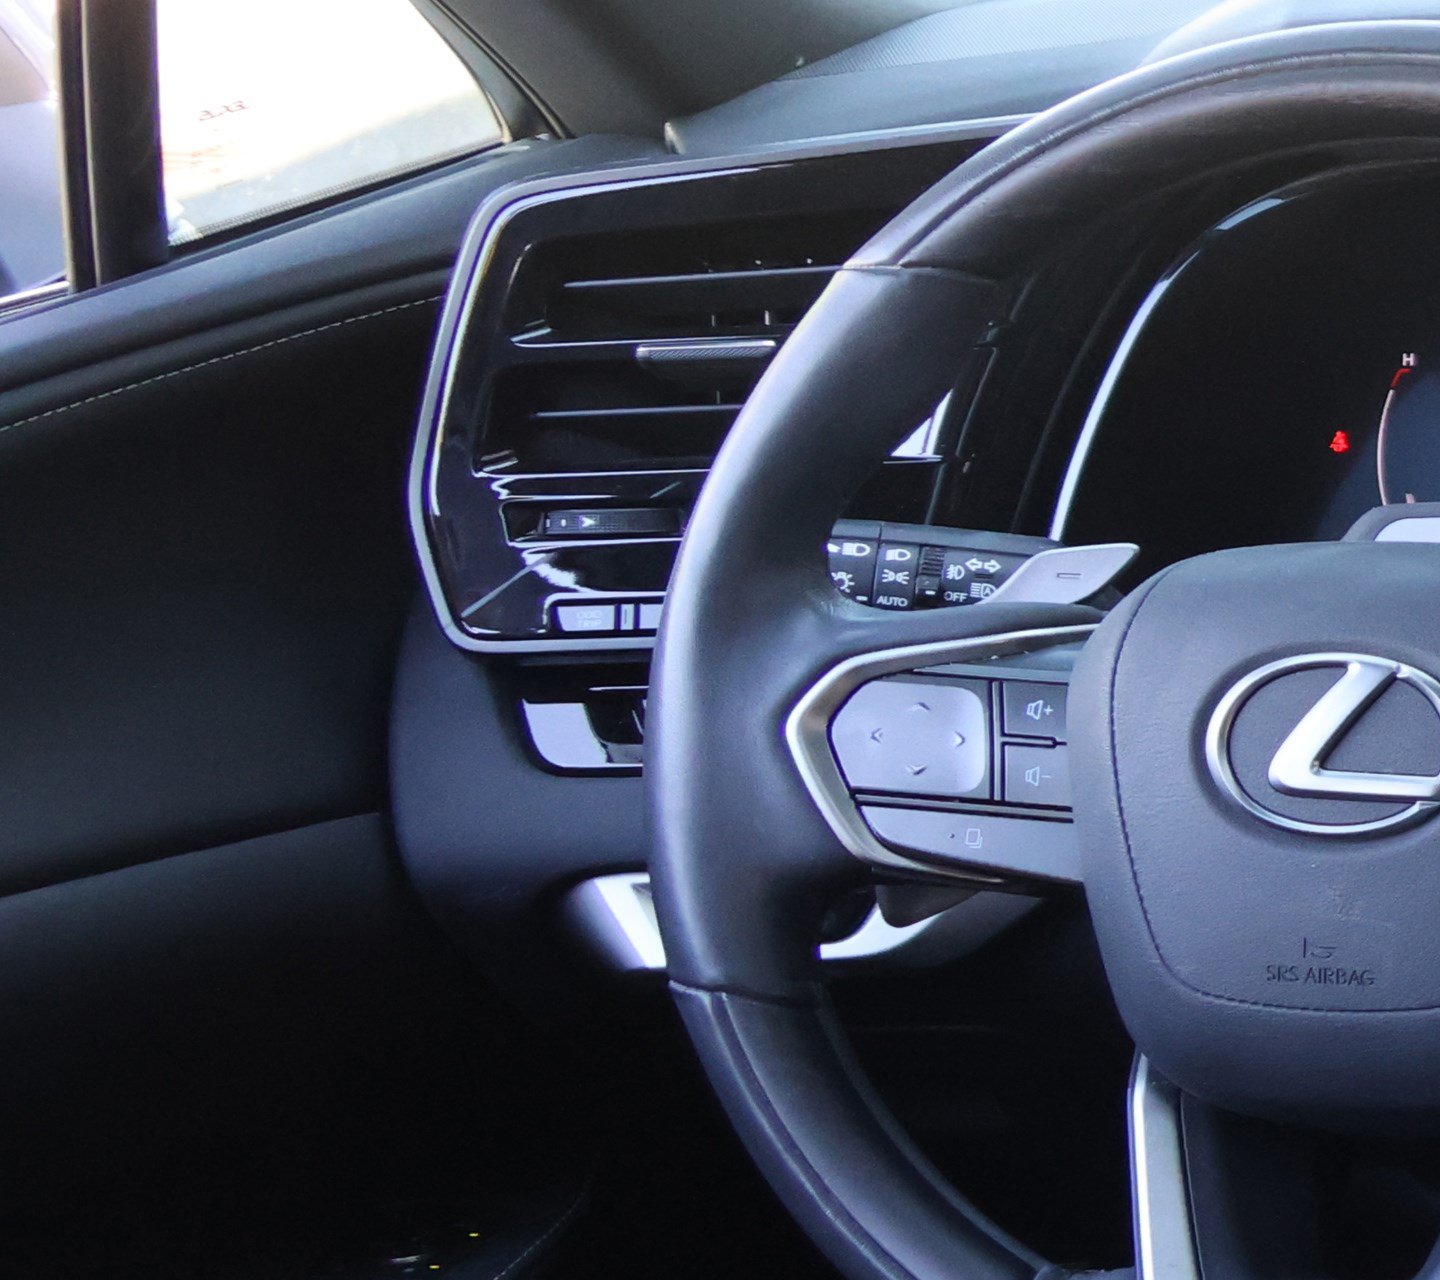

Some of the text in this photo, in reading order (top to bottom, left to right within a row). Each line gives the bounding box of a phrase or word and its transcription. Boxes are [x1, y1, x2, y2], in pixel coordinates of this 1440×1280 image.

[1402, 352, 1415, 367] H
[877, 595, 908, 608] AUTO
[1267, 964, 1378, 986] SRS AIRBAG
